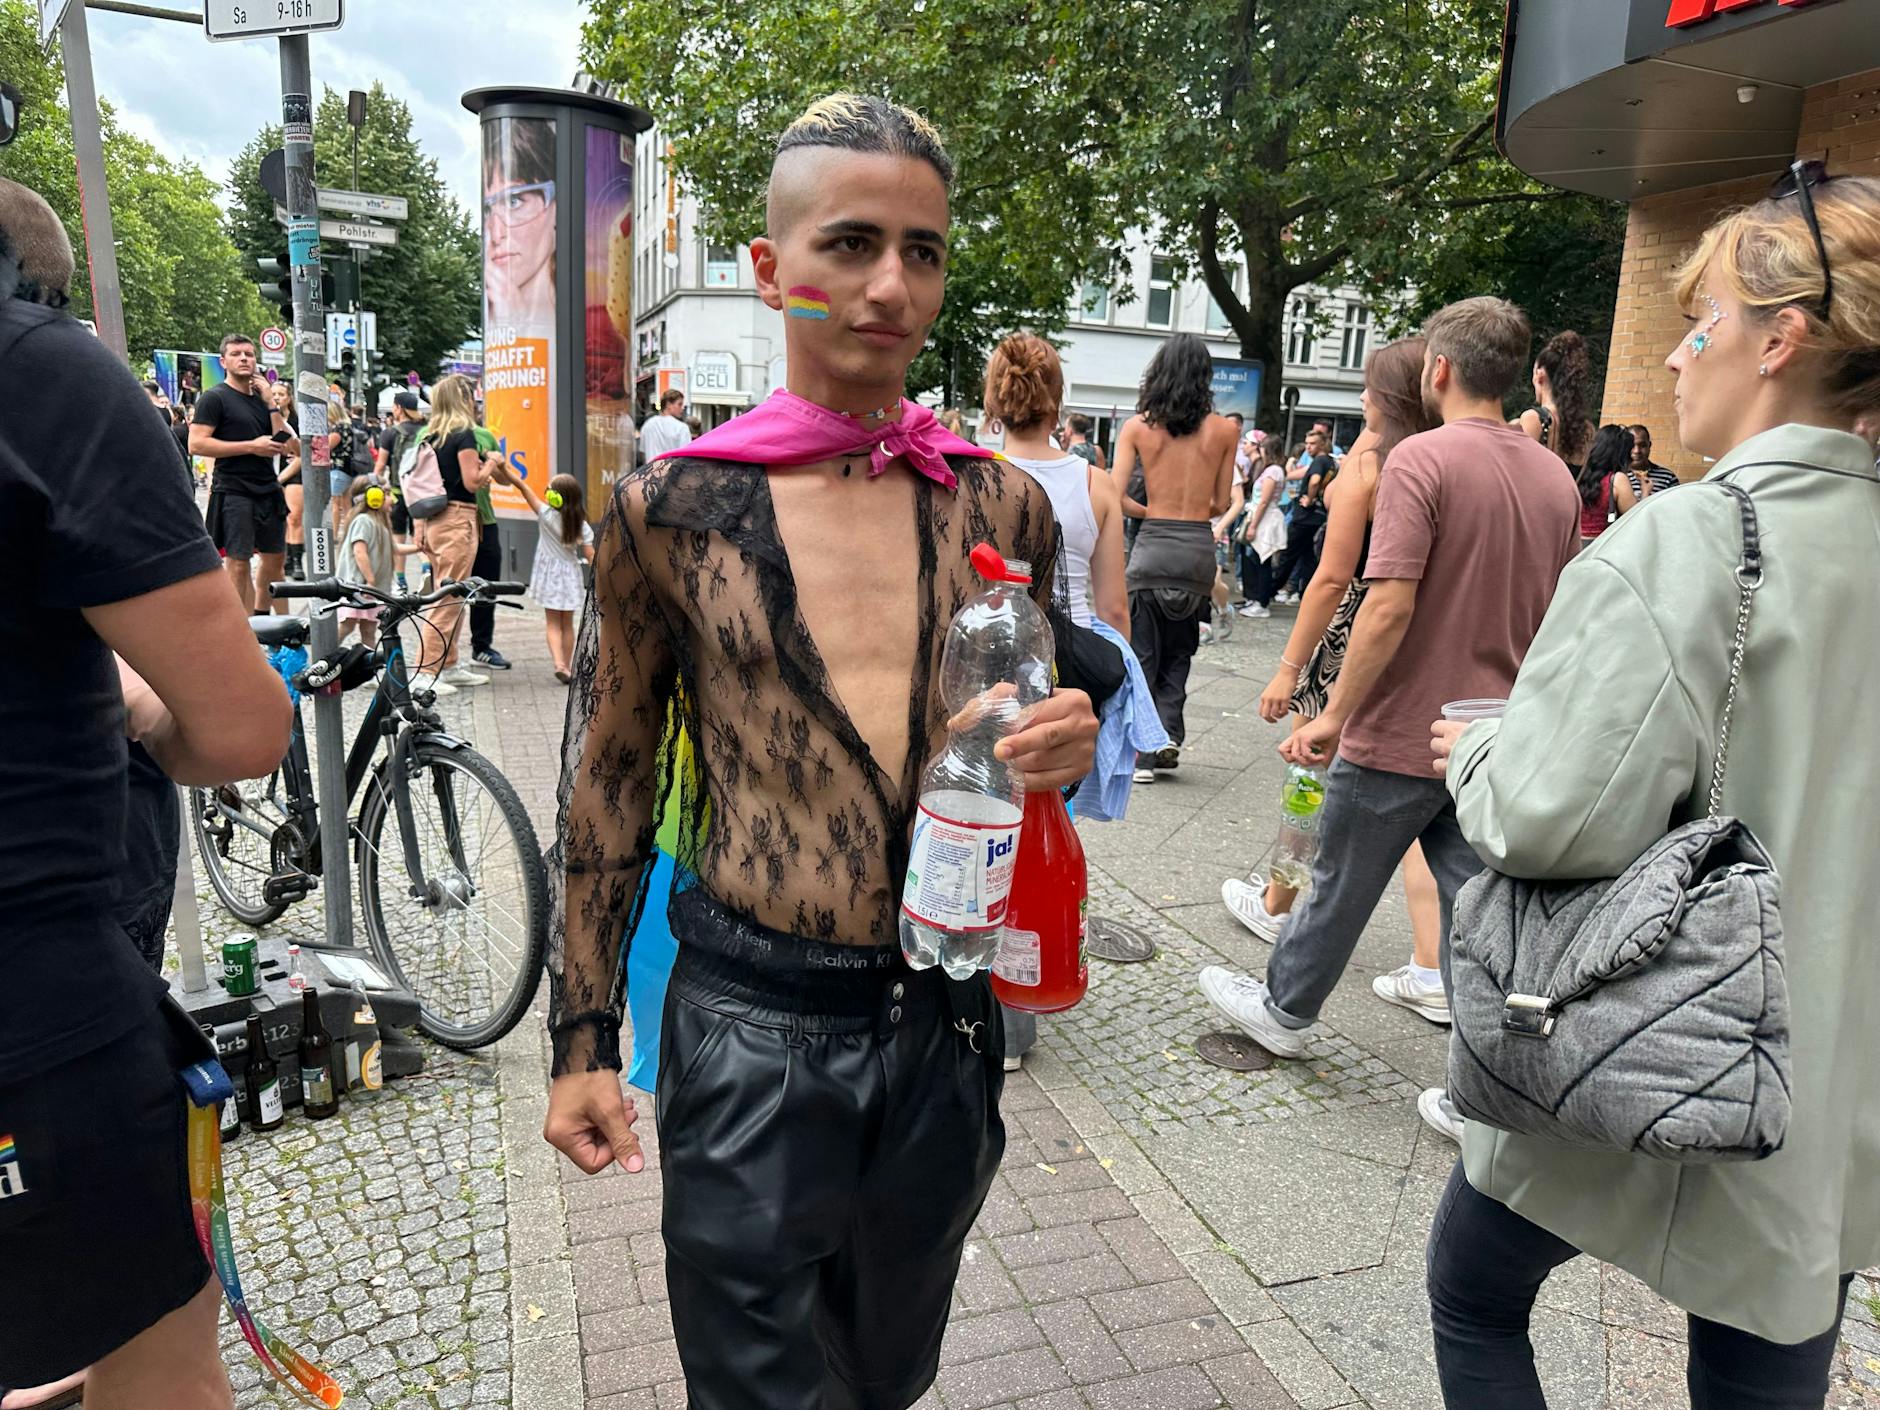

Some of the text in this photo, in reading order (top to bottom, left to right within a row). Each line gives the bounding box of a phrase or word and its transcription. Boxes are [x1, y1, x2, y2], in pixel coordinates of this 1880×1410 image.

[233, 6, 247, 24] Sa
[305, 0, 312, 17] h
[339, 224, 378, 239] Pohlstr.
[266, 334, 281, 346] 30
[696, 373, 729, 388] DELI
[1228, 372, 1248, 382] mal
[986, 833, 1013, 868] ja!
[215, 1224, 235, 1287] human kind
